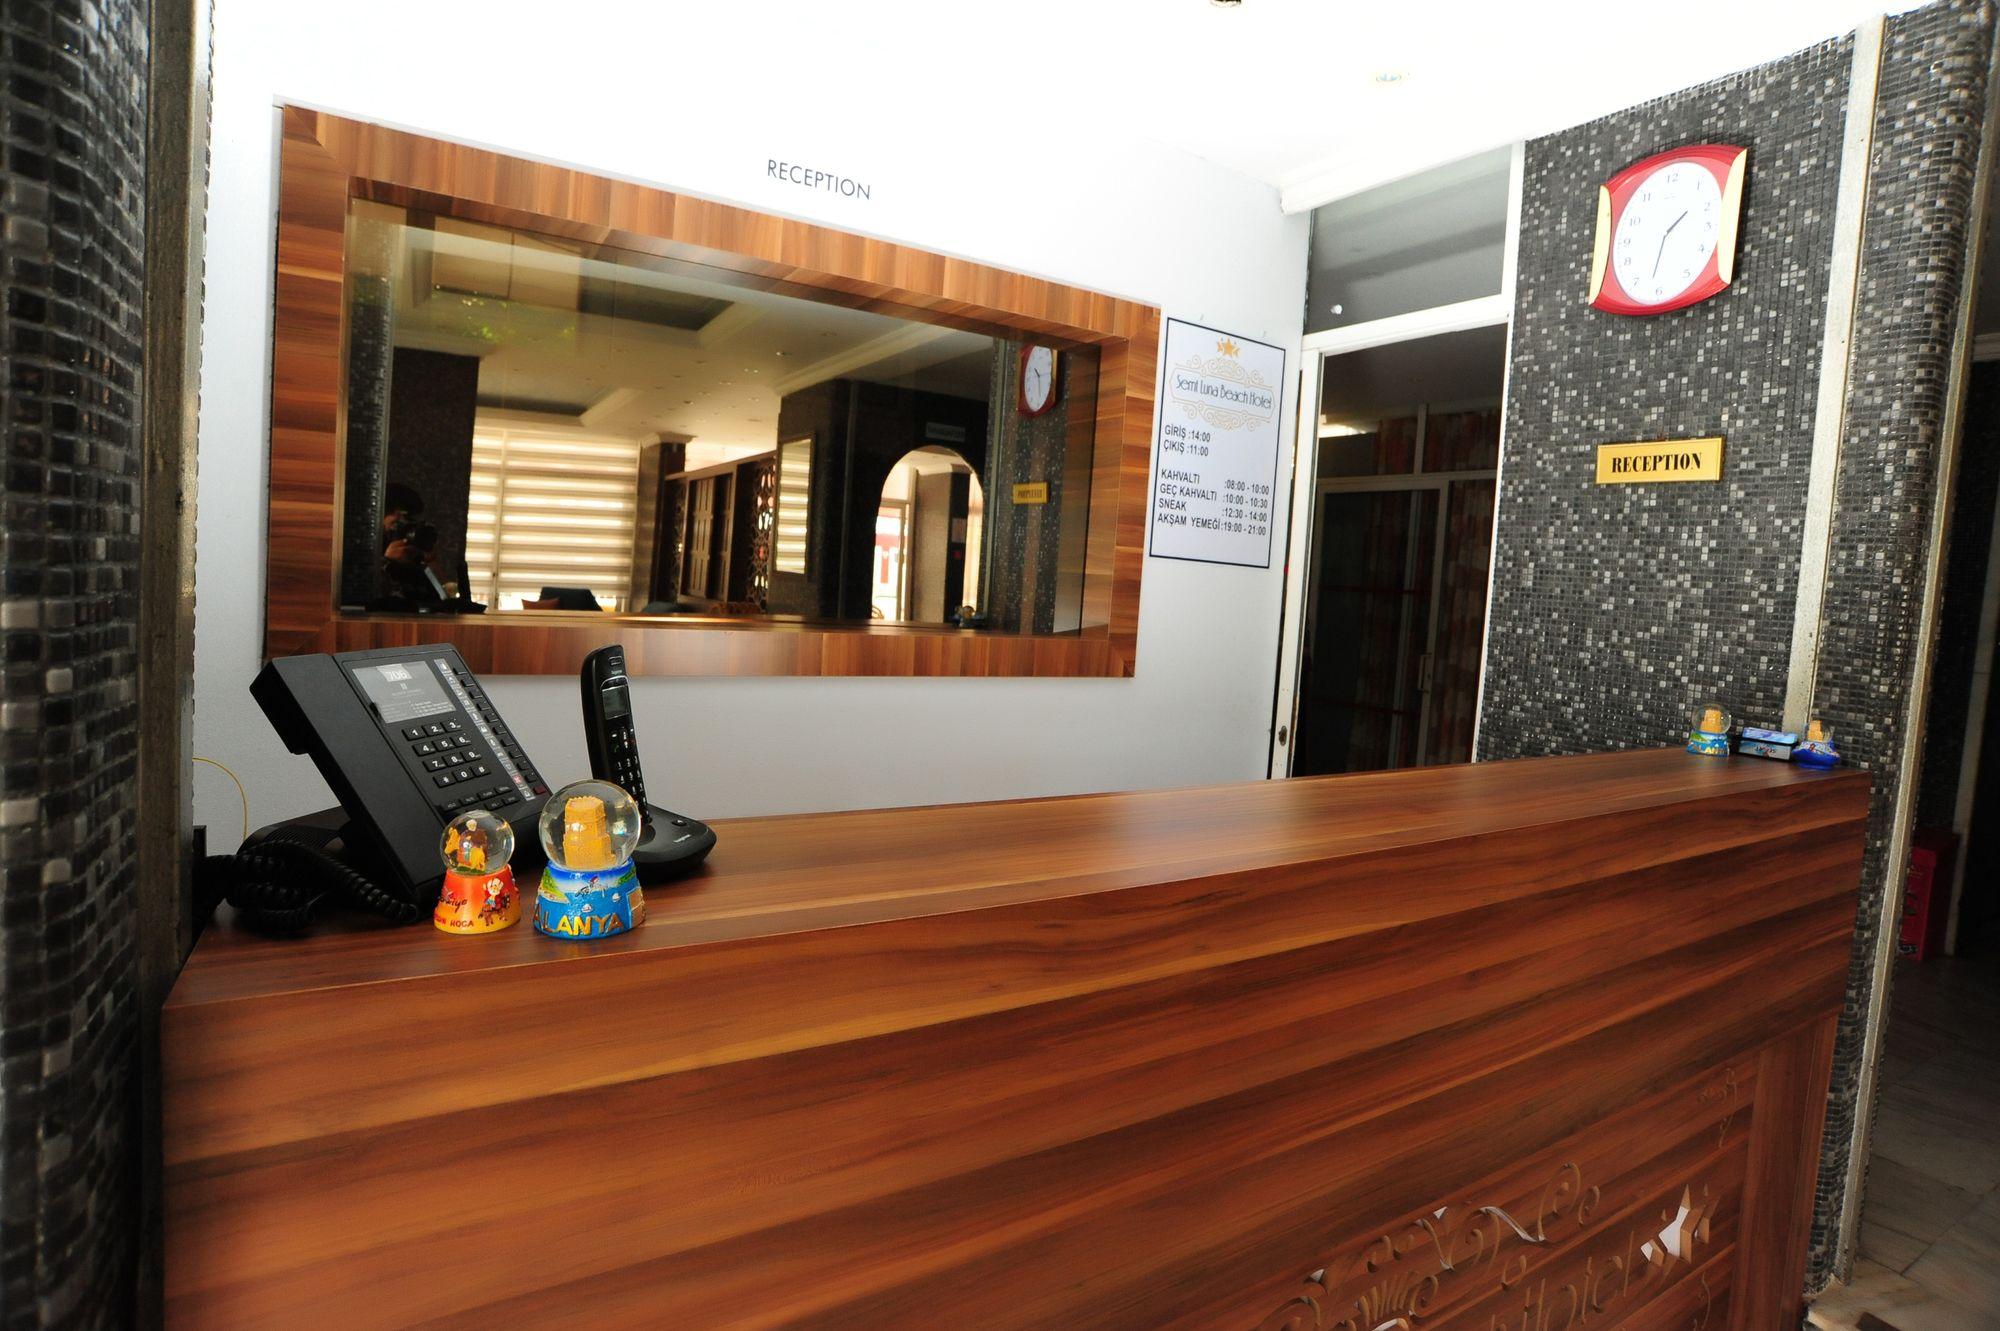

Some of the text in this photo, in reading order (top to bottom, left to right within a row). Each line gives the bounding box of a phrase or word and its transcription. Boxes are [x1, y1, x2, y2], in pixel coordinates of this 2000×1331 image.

[767, 159, 871, 200] RECEPTION
[1200, 380, 1218, 397] Luna
[1220, 384, 1248, 404] Beach
[1248, 391, 1272, 409] Hotel
[1164, 423, 1186, 440] GİRİŞ
[1163, 439, 1185, 454] ÇIKIŞ
[1612, 452, 1702, 473] RECEPTION
[1161, 468, 1200, 484] KAHVALTI
[1251, 483, 1270, 495] 10:00
[1160, 483, 1177, 498] GEÇ
[1180, 487, 1217, 501] KAHVALTI
[1250, 497, 1268, 509] 10:30
[1158, 498, 1187, 511] SNEAK
[1249, 511, 1267, 523] 14:00
[1157, 513, 1187, 527] AKŞAM
[1247, 524, 1266, 536] 21:00
[533, 903, 625, 936] ALANYA
